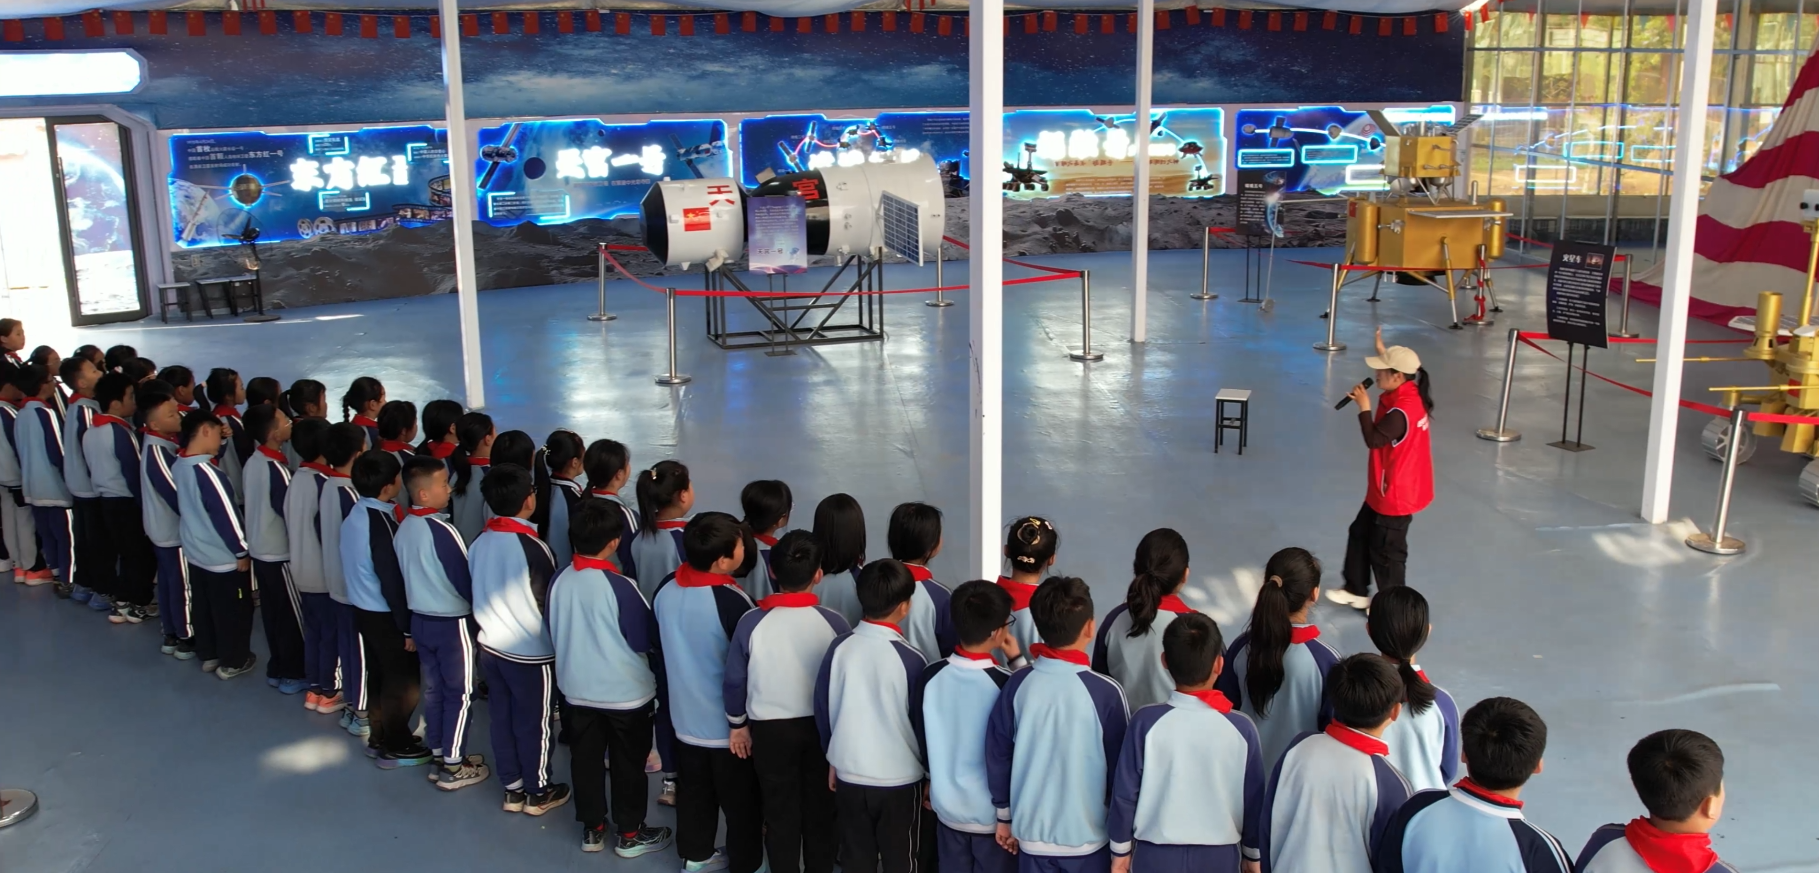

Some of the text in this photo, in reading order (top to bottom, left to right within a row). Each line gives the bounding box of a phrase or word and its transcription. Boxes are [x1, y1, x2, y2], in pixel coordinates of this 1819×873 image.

[707, 178, 820, 206] 天 宫
[1562, 253, 1582, 264] 火星车
